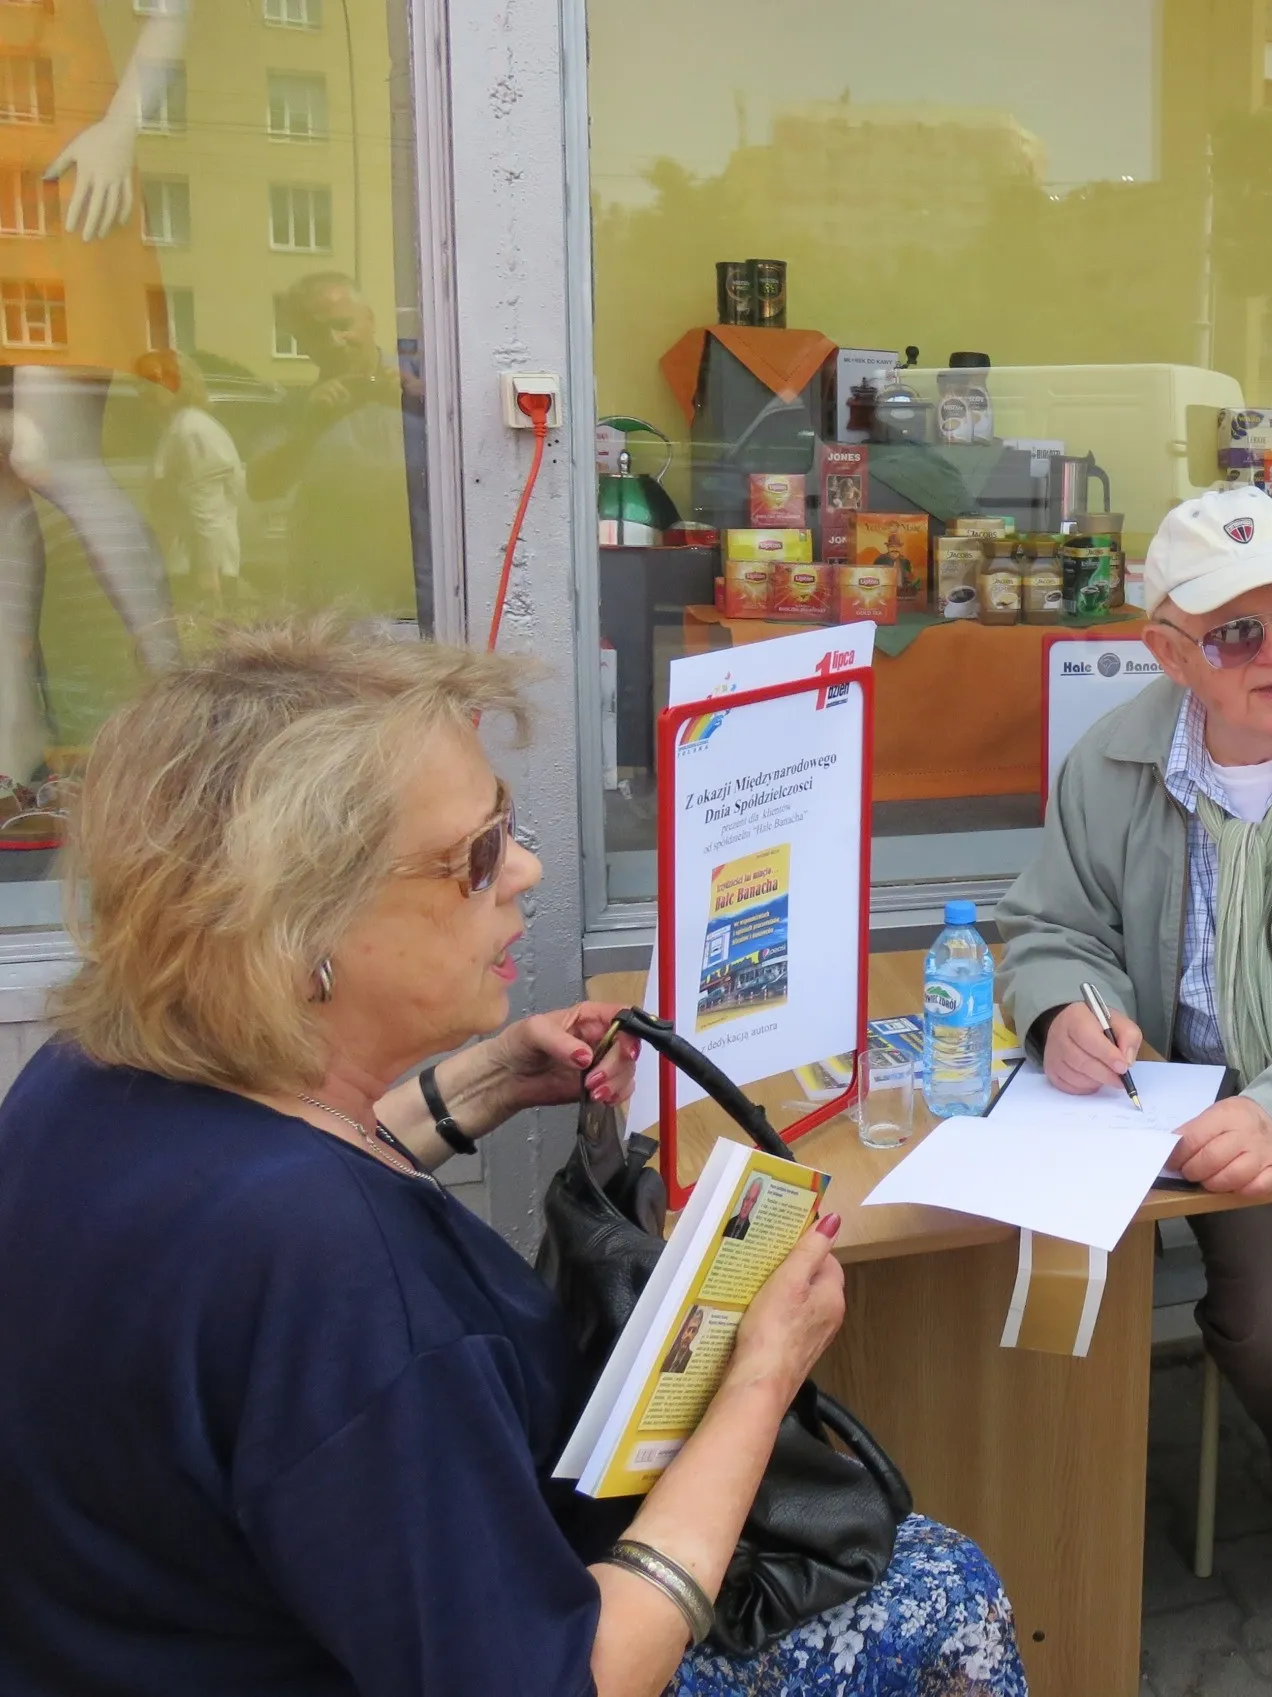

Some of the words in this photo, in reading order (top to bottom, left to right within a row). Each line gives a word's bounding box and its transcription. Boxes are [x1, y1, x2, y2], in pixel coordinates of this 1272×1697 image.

[827, 453, 861, 462] JONES
[970, 530, 998, 538] JACOBS
[828, 536, 848, 544] JON
[759, 540, 782, 551] Lipton
[950, 551, 973, 559] JACOBS
[795, 574, 815, 583] Lipton
[860, 577, 879, 586] Lipton
[994, 577, 1014, 585] JACOBS
[1036, 577, 1056, 585] JACOBS
[1063, 661, 1092, 673] Hale
[815, 651, 832, 711] 1
[832, 650, 855, 669] lipca
[685, 793, 694, 810] Z
[697, 781, 732, 805] okazji
[734, 753, 837, 793] Międzynarodowego
[704, 804, 731, 824] Dnia
[715, 892, 735, 912] Hale
[737, 878, 778, 903] Banacha
[939, 997, 957, 1010] ZDRÓJ
[707, 1030, 749, 1051] dedykacją
[751, 1022, 778, 1036] autora
